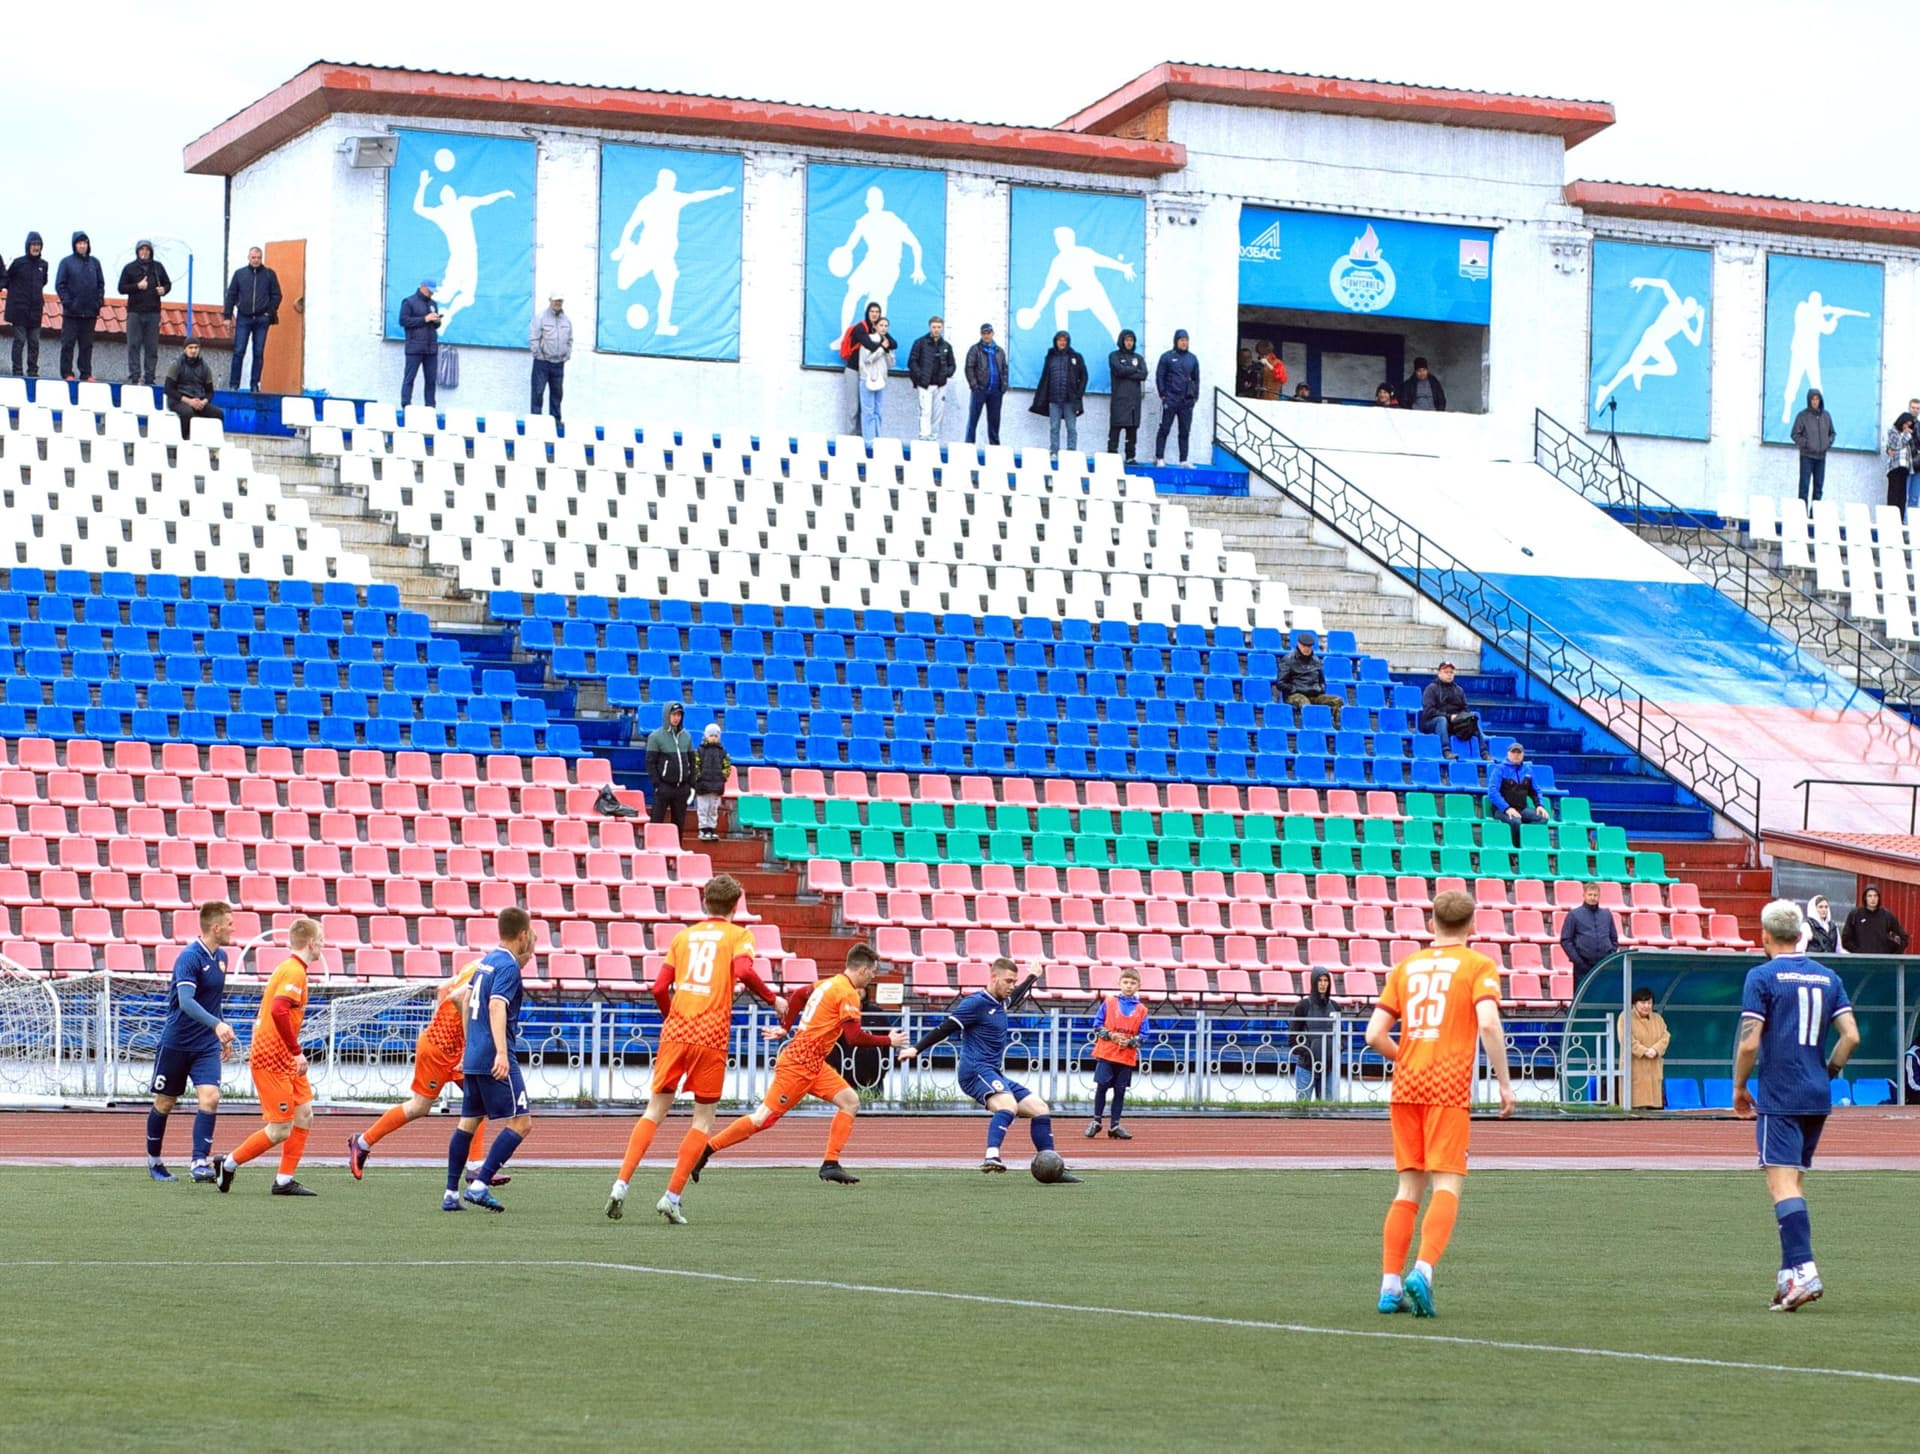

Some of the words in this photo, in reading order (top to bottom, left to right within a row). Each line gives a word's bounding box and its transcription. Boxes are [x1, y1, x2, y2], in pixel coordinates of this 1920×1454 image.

[1240, 246, 1282, 260] УЗБАСС
[685, 941, 717, 984] 18
[469, 974, 484, 1020] 4
[1407, 973, 1452, 1028] 25
[1798, 987, 1822, 1046] 11
[154, 1074, 167, 1091] 6
[517, 1091, 528, 1110] 4
